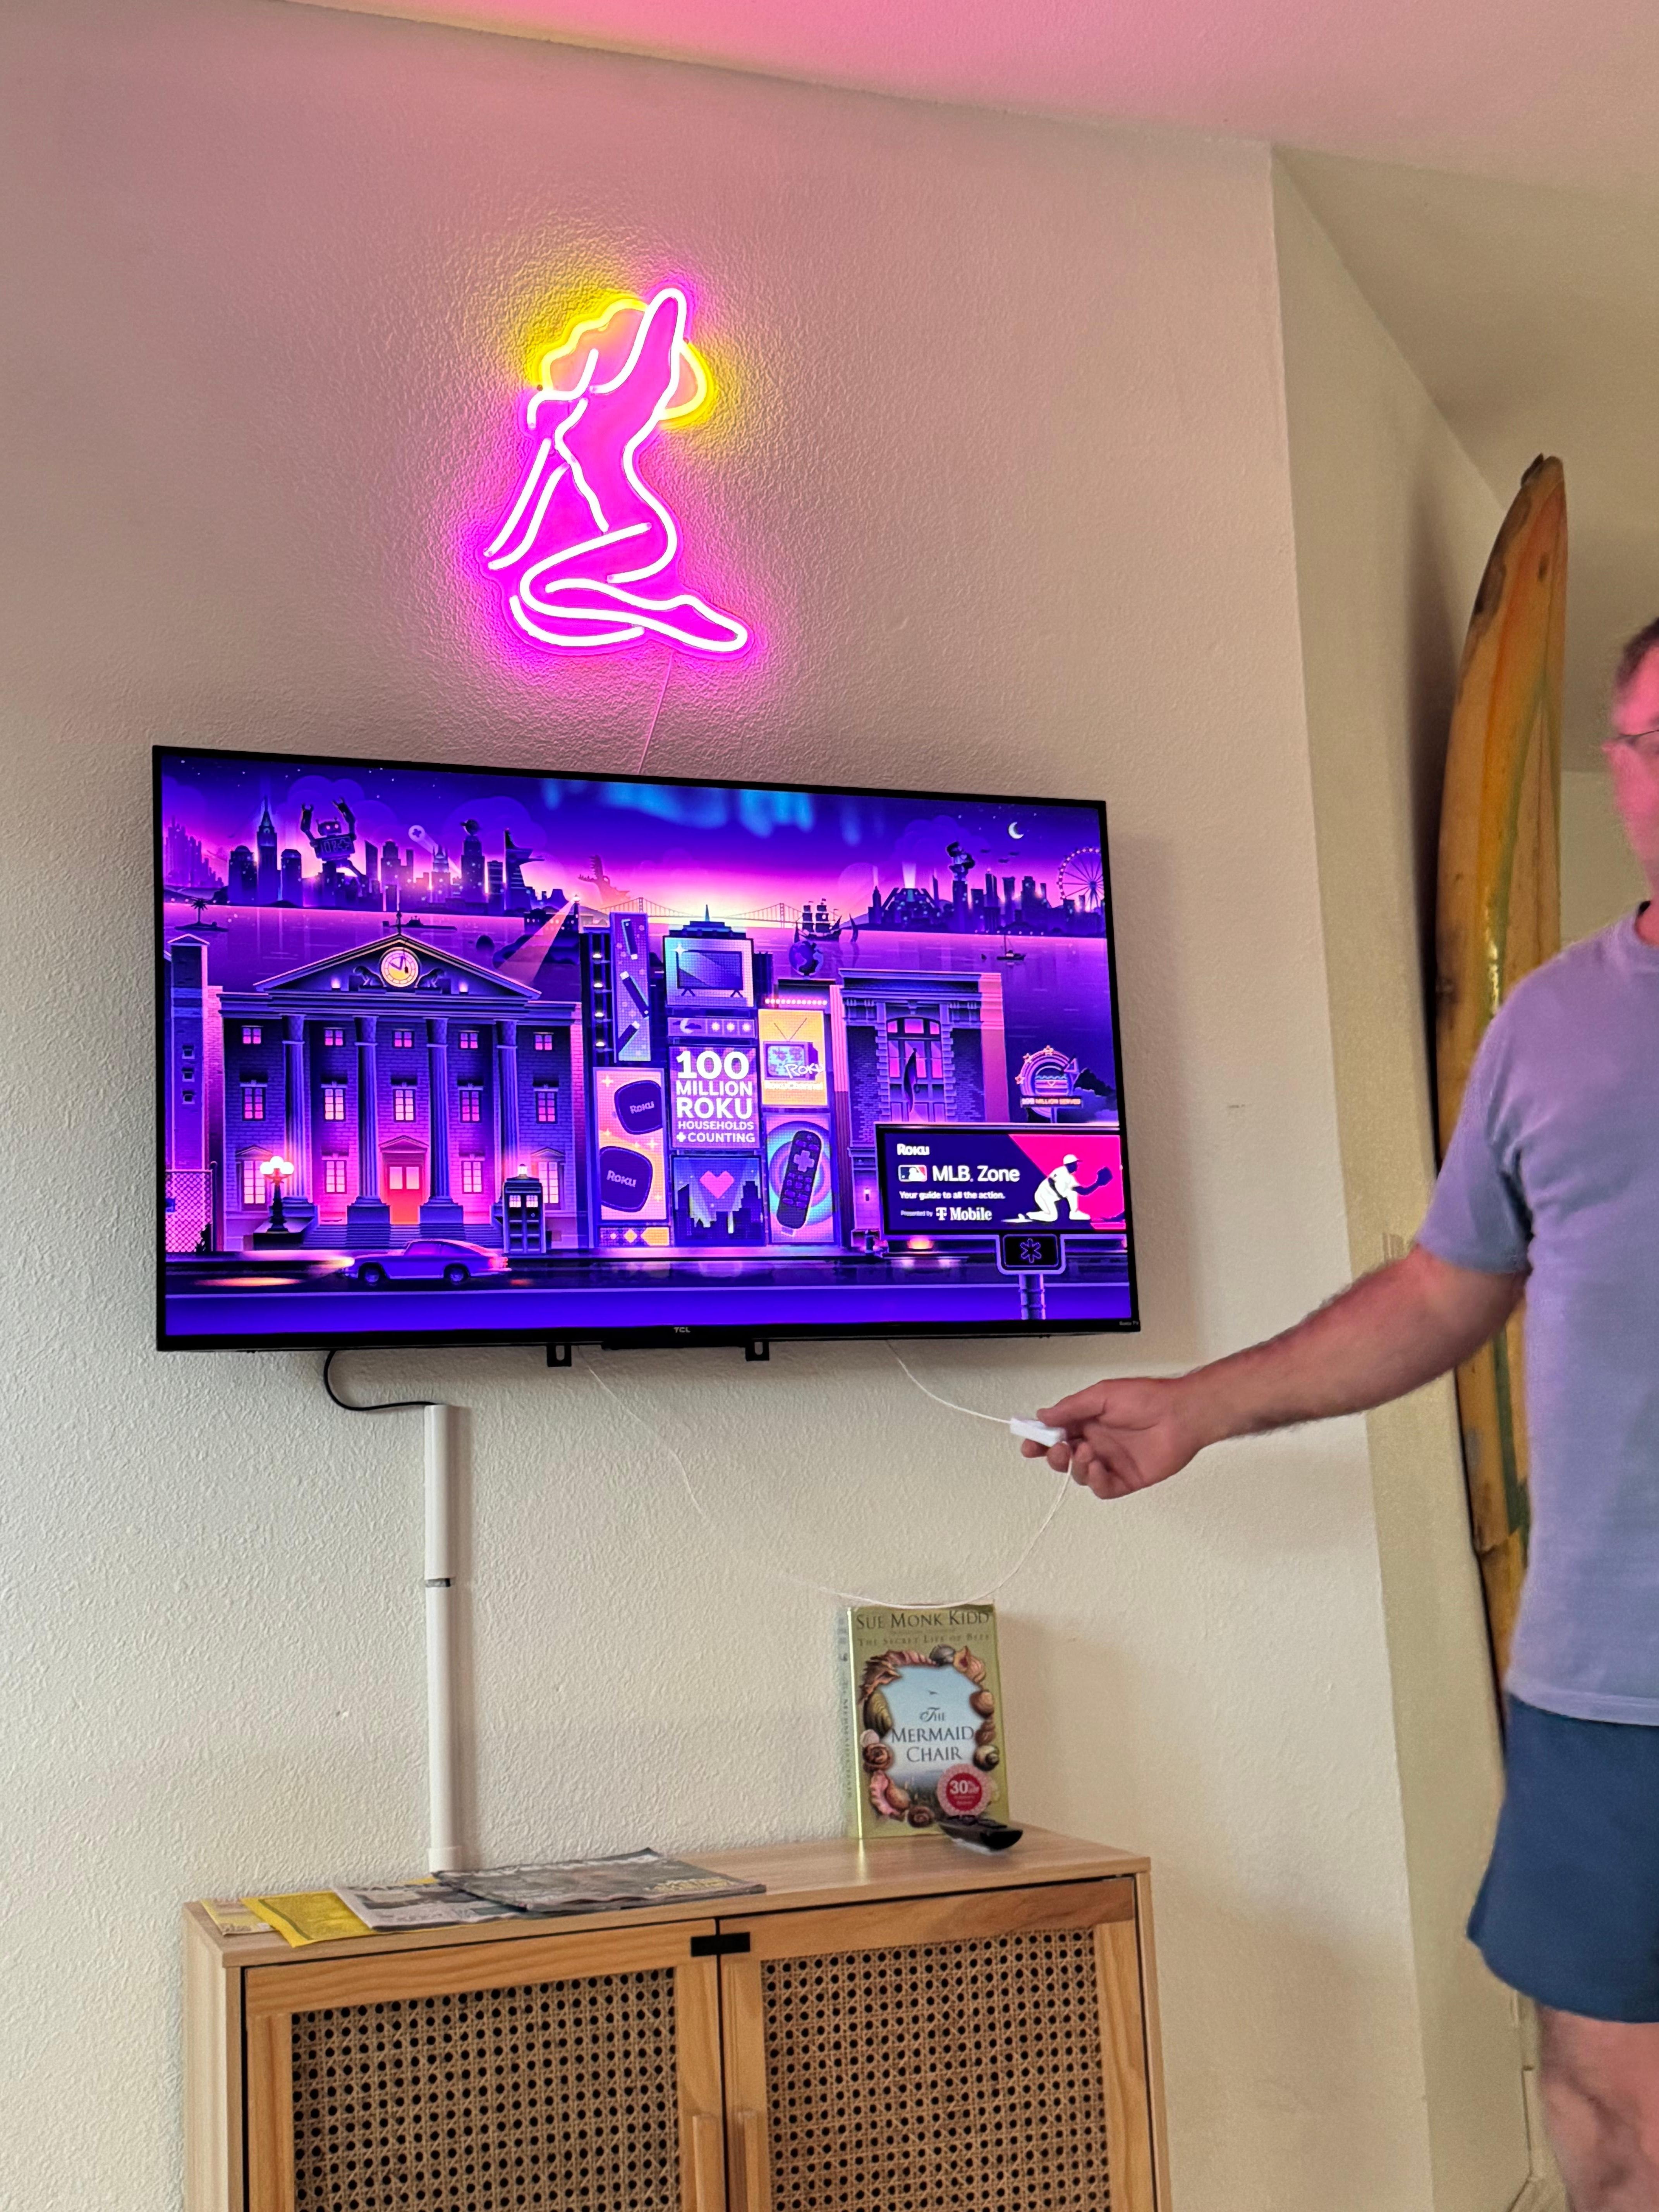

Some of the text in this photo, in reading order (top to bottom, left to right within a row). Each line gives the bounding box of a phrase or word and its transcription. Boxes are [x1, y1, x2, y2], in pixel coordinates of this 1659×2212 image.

[676, 1051, 749, 1080] 100
[676, 1080, 752, 1096] MILLION
[677, 1097, 752, 1119] ROKU
[678, 1121, 754, 1130] HOUSEHOLDS
[977, 1165, 1020, 1182] Zone
[899, 1191, 917, 1199] Your
[919, 1191, 941, 1200] guide
[950, 1207, 992, 1221] Mobile
[856, 1610, 989, 1629] SUE MONK KIDD
[891, 1726, 974, 1743] MERMAID
[906, 1746, 963, 1762] CHAIR
[950, 1780, 968, 1794] 30
